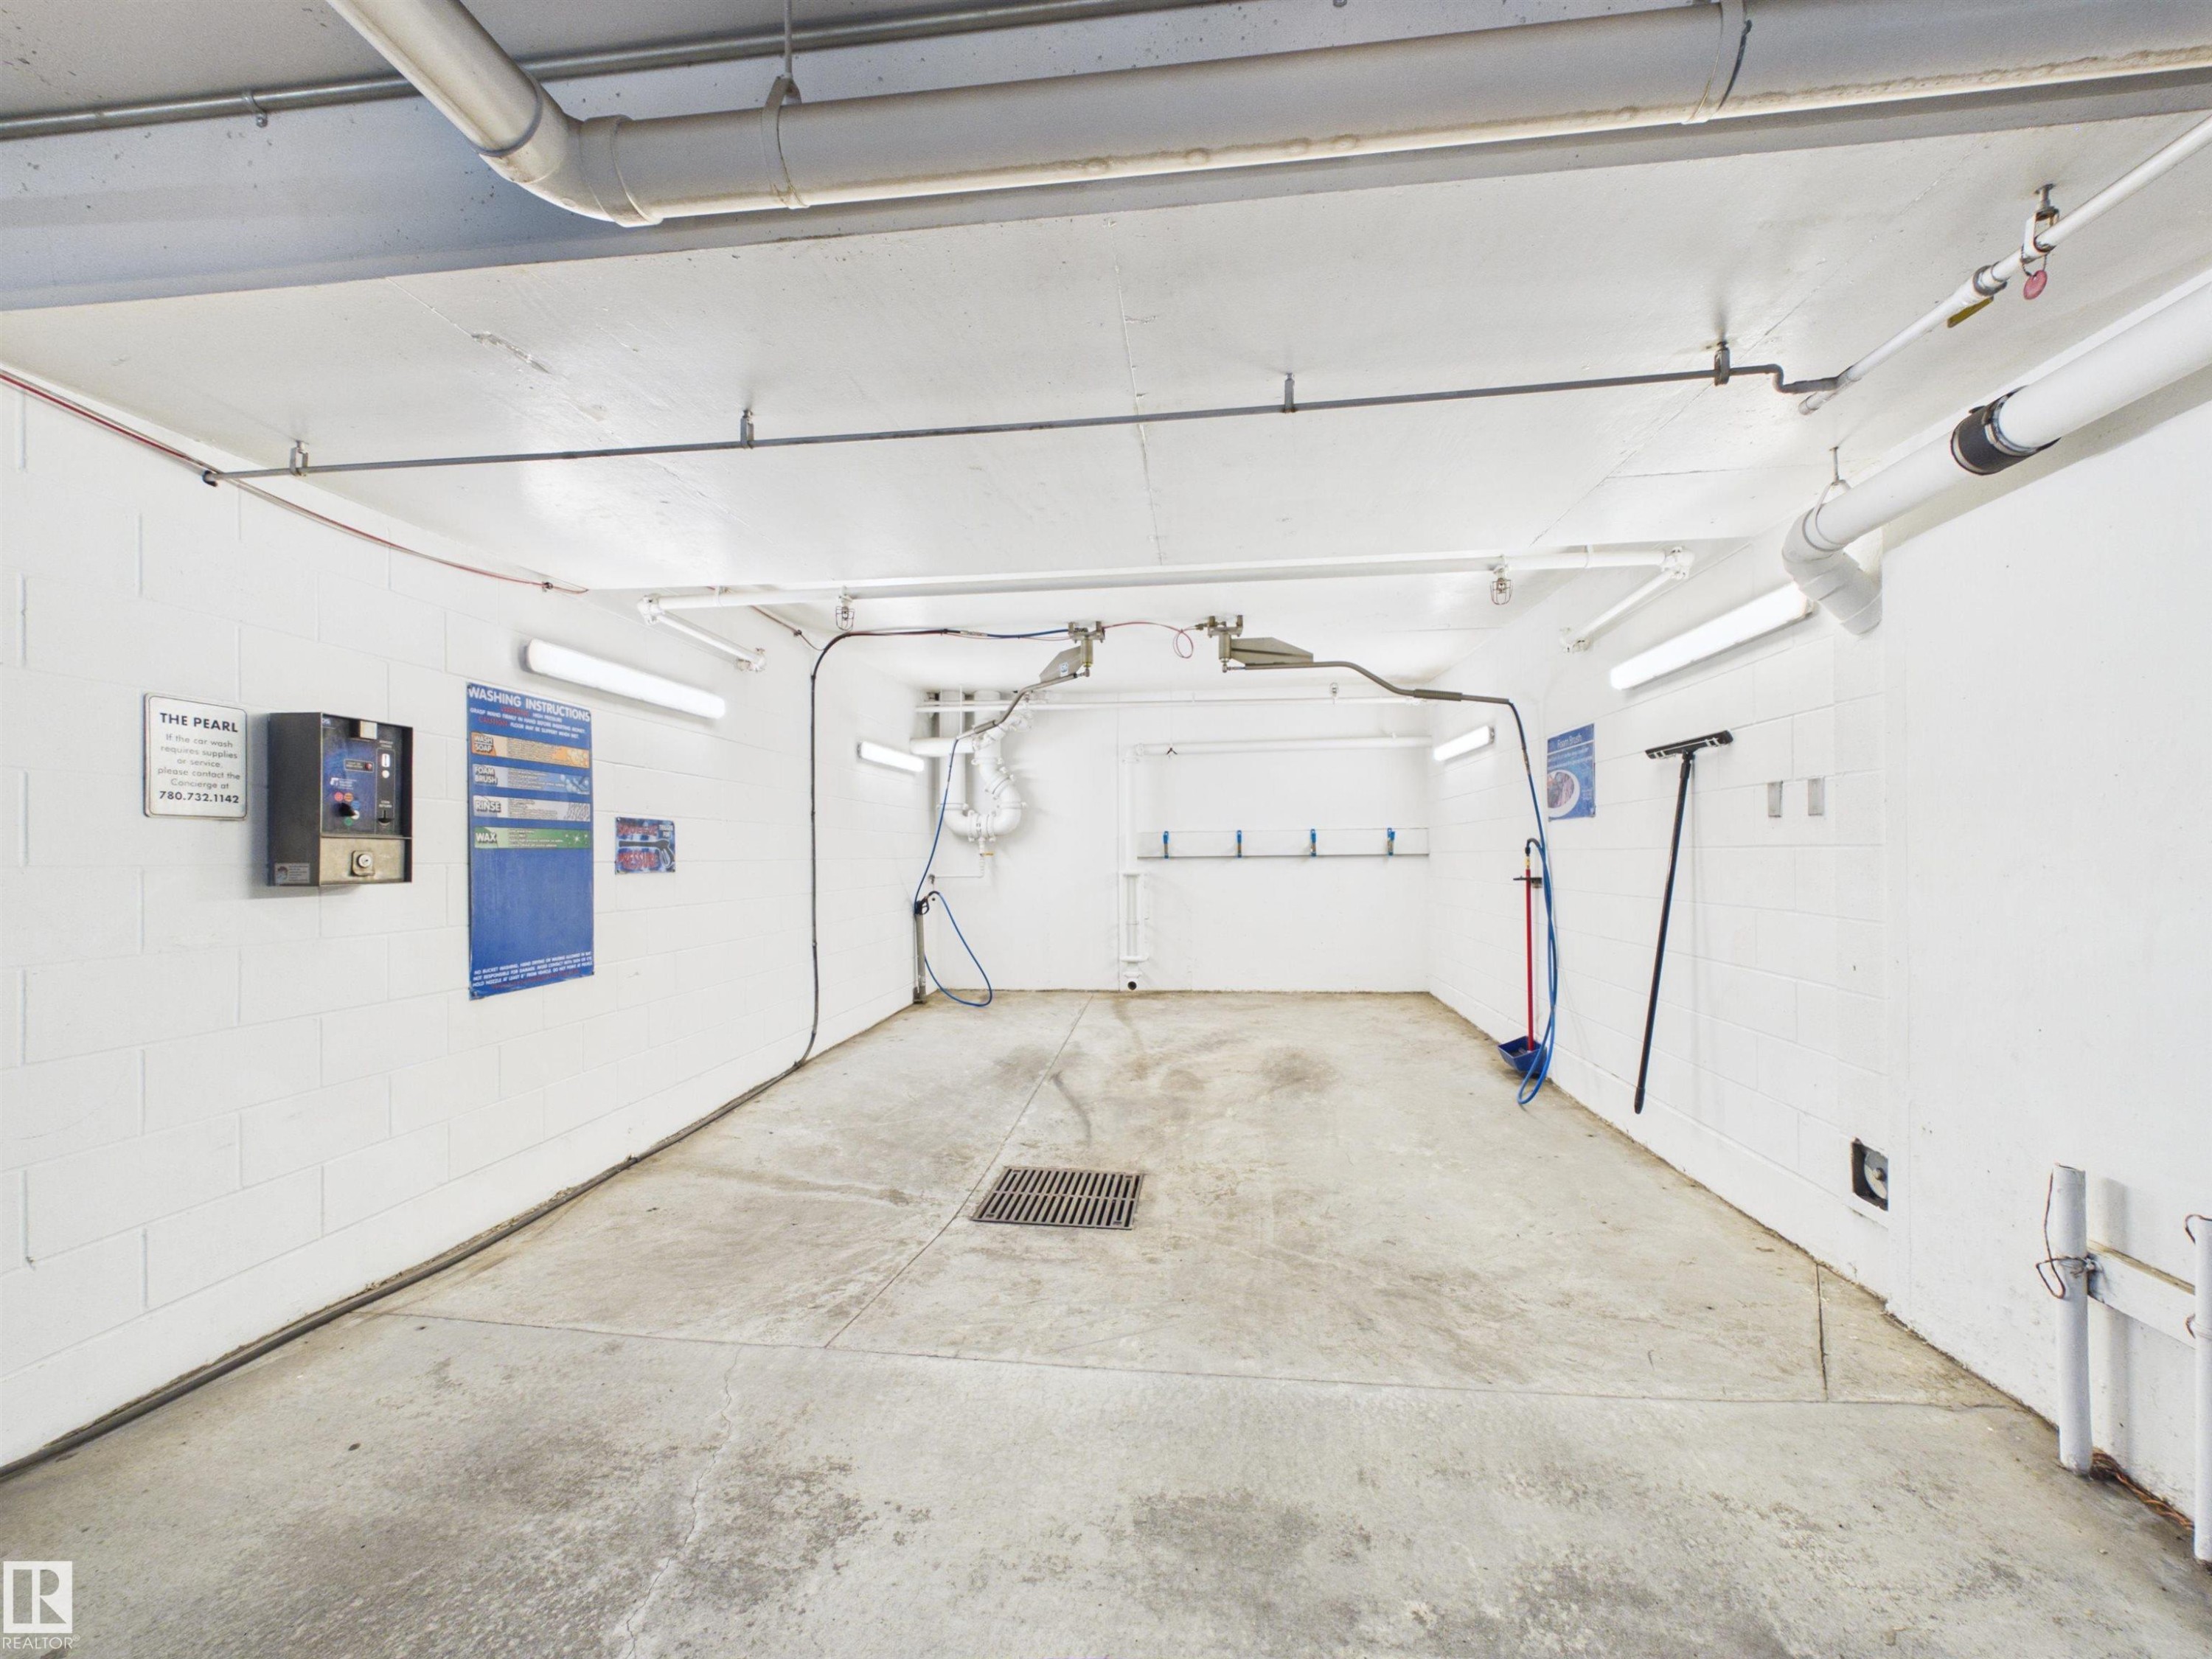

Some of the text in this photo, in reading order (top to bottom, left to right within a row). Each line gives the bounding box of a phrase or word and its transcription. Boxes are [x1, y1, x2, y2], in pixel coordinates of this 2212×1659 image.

[468, 686, 521, 707] WASHING
[526, 698, 590, 722] INSTRUCTIONS
[160, 713, 238, 732] THE PEARL
[210, 740, 232, 748] wash
[475, 735, 493, 743] WASH
[161, 745, 237, 759] requires supplies
[475, 744, 493, 752] SOAP
[158, 767, 240, 780] please contact the
[474, 766, 495, 776] FOAM
[170, 778, 217, 790] Concierge
[475, 776, 497, 785] BRUSH
[159, 791, 239, 804] 780.732.1142
[475, 801, 501, 812] RINSE
[476, 832, 497, 843] WAX
